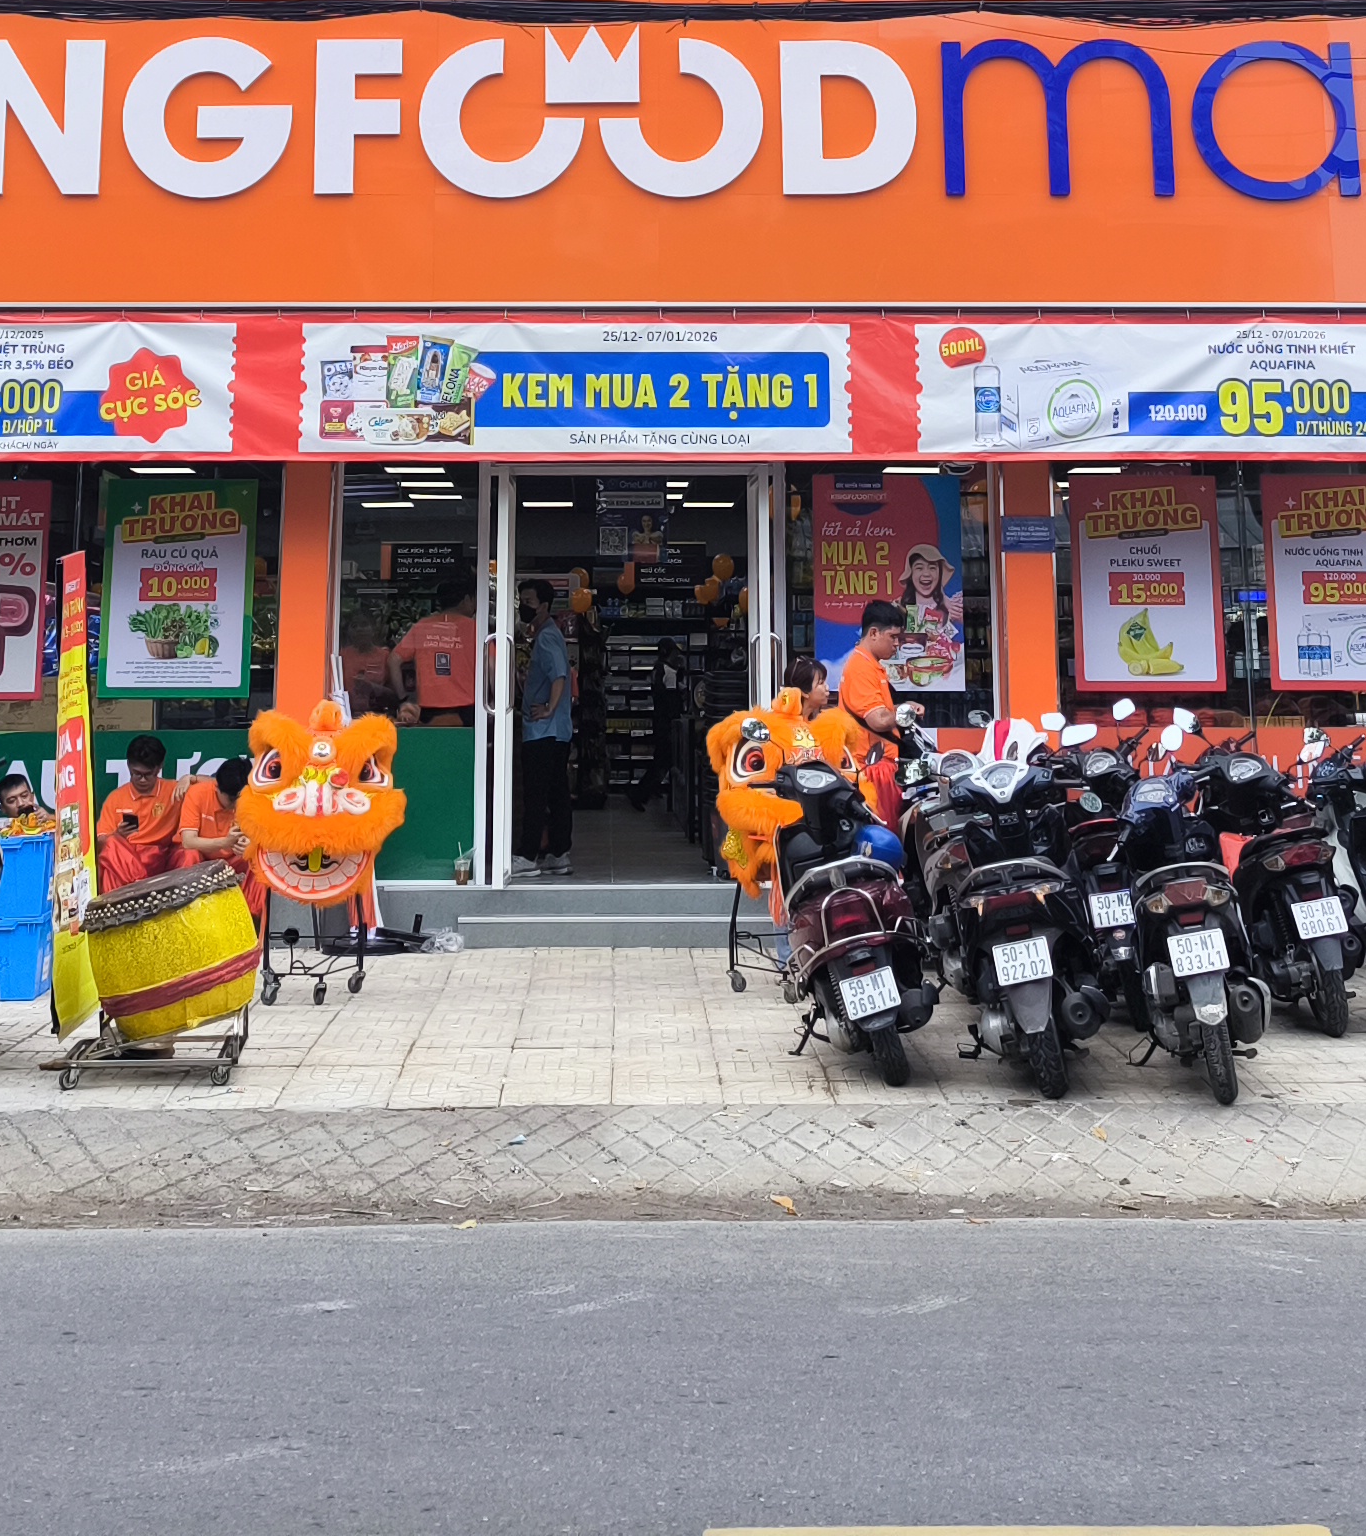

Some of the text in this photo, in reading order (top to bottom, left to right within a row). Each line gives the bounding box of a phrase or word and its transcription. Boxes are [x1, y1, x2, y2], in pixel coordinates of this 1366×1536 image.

[646, 331, 719, 344] 07/01/2026
[941, 337, 983, 357] 500ML
[1207, 342, 1244, 355] NƯỚC
[1249, 359, 1316, 371] AQUAFINA
[125, 366, 166, 391] GIÁ
[99, 384, 202, 424] CỰC SỐC
[502, 365, 818, 421] KEM MUA 2 TẶNG 1
[569, 429, 751, 448] SẢN CÙNG LOẠI
[149, 492, 213, 514] KHAI
[1111, 487, 1174, 510] KHAI
[1303, 487, 1366, 510] KHAI
[123, 511, 238, 538] TRƯƠNG
[865, 519, 897, 537] kem
[1087, 507, 1199, 532] TRƯƠNG
[141, 545, 219, 561] RAU QUẢ
[821, 541, 890, 566] MUA 2
[1146, 558, 1182, 568] SWEET
[1315, 558, 1363, 568] AQUAFINA
[147, 575, 211, 598] 10.000
[821, 565, 878, 600] TẶNG
[1117, 582, 1178, 603] 15.000
[1301, 915, 1344, 936] 980.61
[1001, 941, 1040, 964] 50-Y1
[1176, 934, 1215, 955] 50-N1
[1001, 958, 1049, 982] 922.02
[1175, 950, 1224, 974] 833.41
[849, 991, 897, 1016] 369.14
